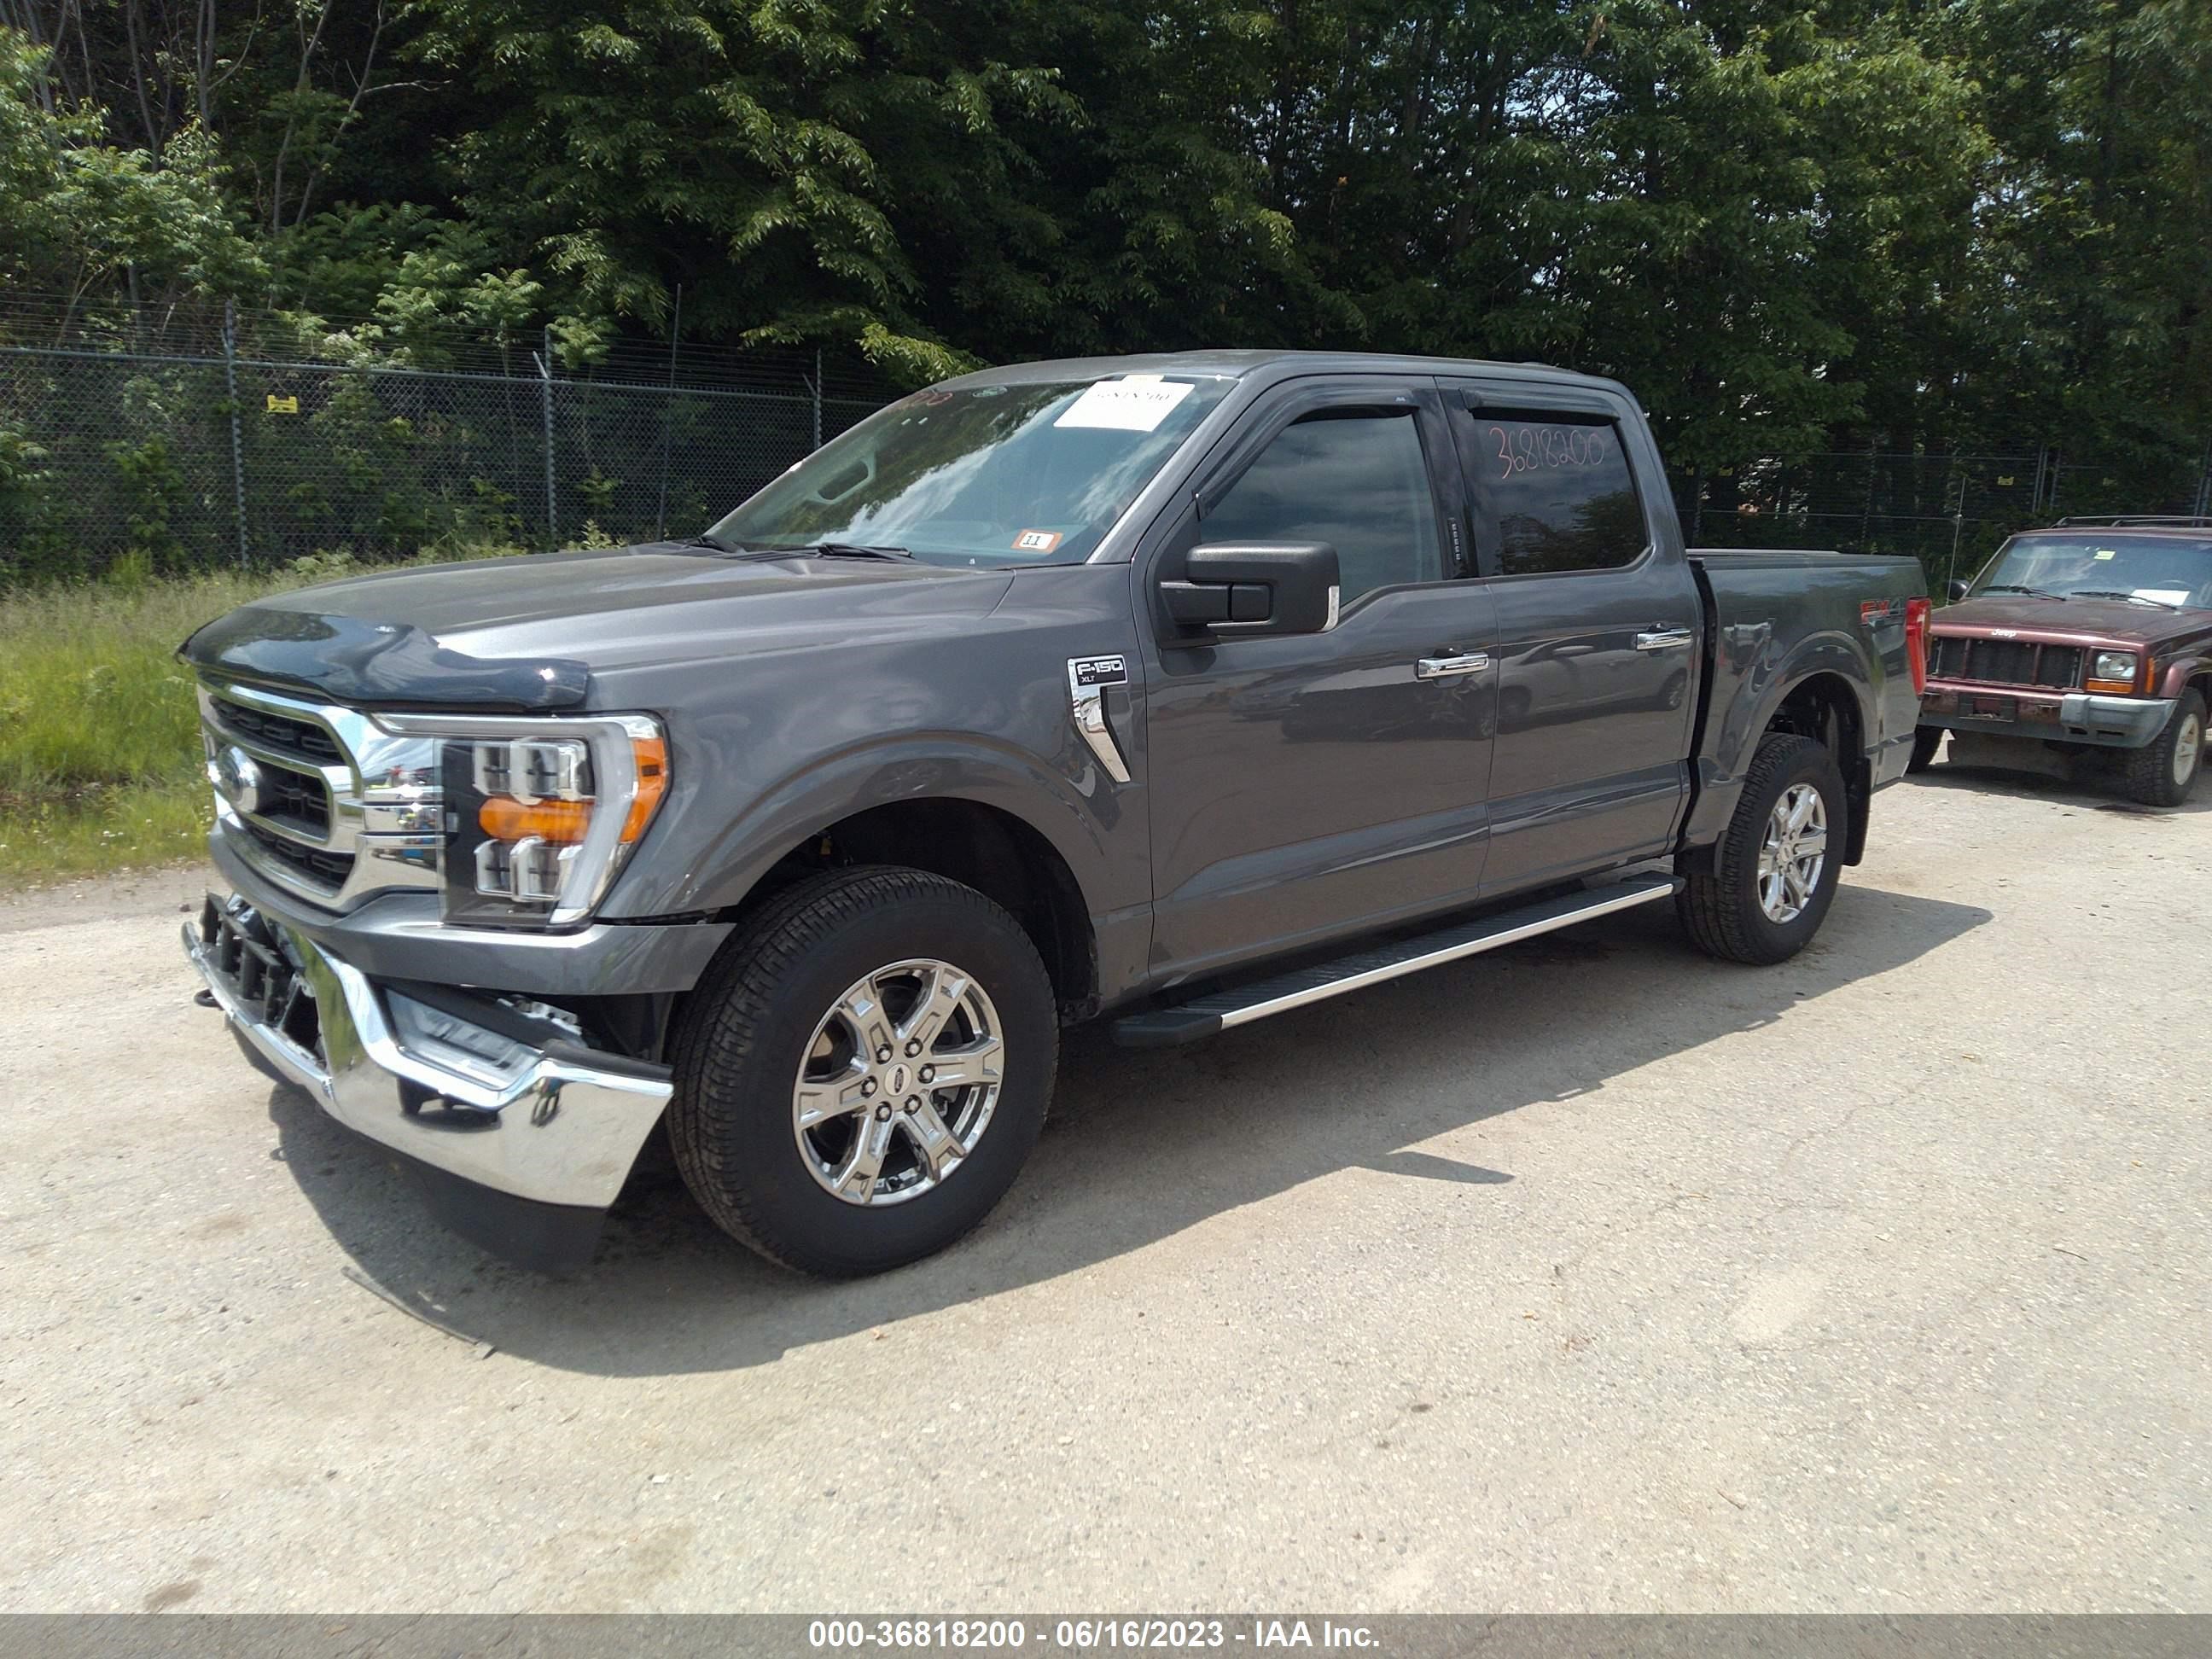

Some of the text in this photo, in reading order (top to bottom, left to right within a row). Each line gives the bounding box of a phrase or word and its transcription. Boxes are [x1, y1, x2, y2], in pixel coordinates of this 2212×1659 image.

[1489, 427, 1604, 479] 36818200
[1022, 534, 1041, 546] 11
[1076, 660, 1124, 675] F-150
